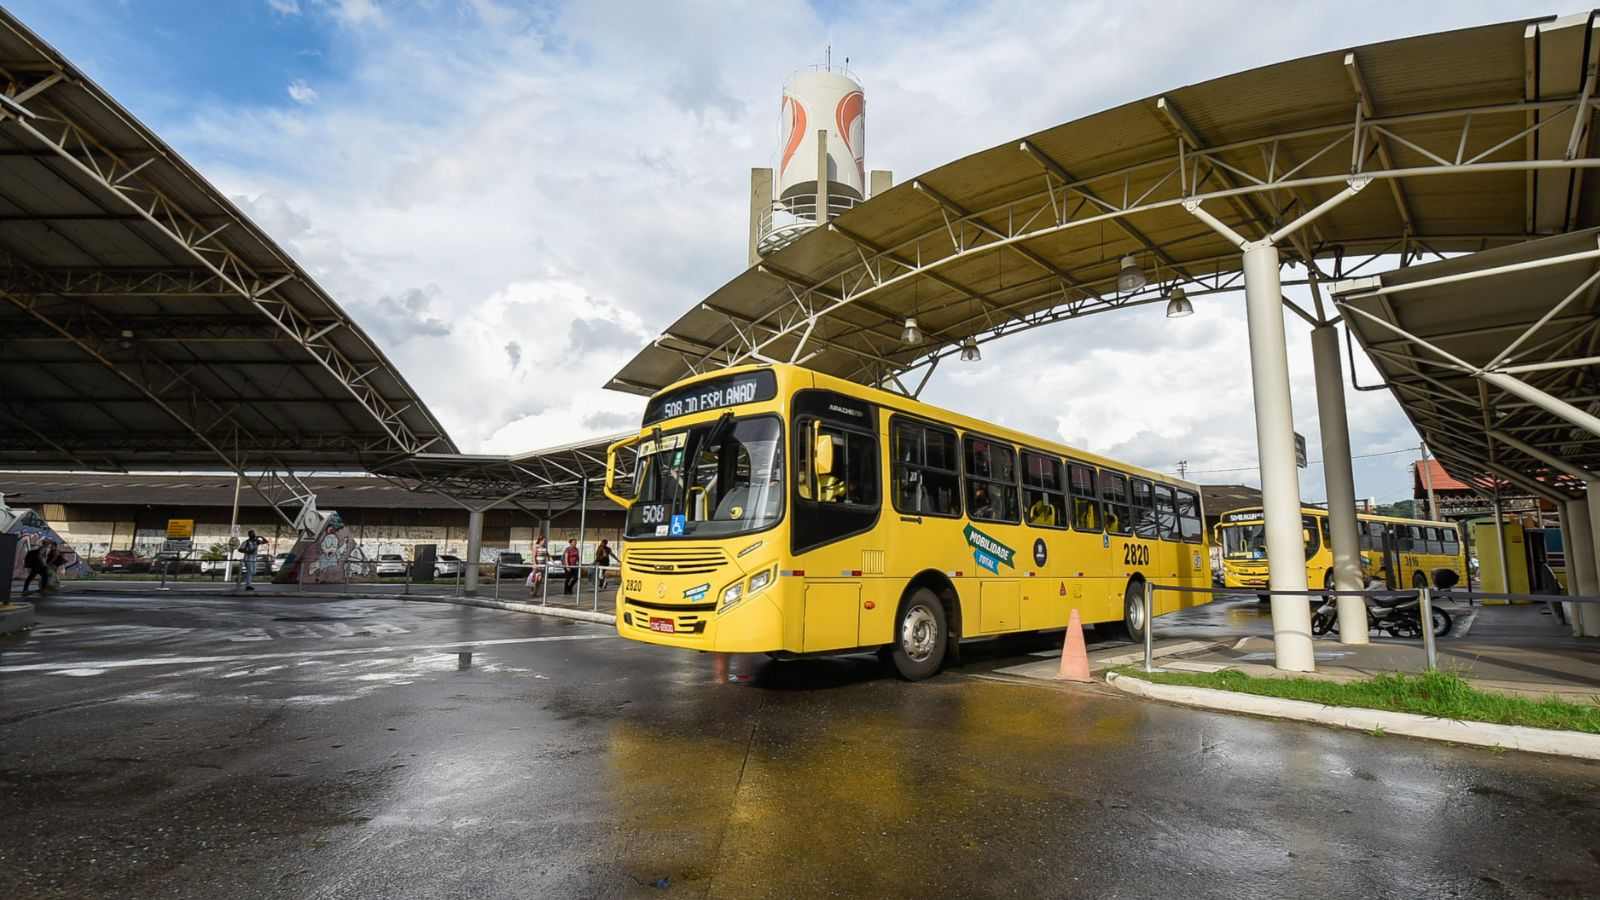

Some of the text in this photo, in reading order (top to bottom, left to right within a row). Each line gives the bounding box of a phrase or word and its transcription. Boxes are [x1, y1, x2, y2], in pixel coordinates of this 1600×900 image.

[642, 505, 664, 523] 508
[969, 530, 1009, 561] MOBILIDADE
[1123, 543, 1150, 565] 2820
[626, 579, 642, 592] 2820
